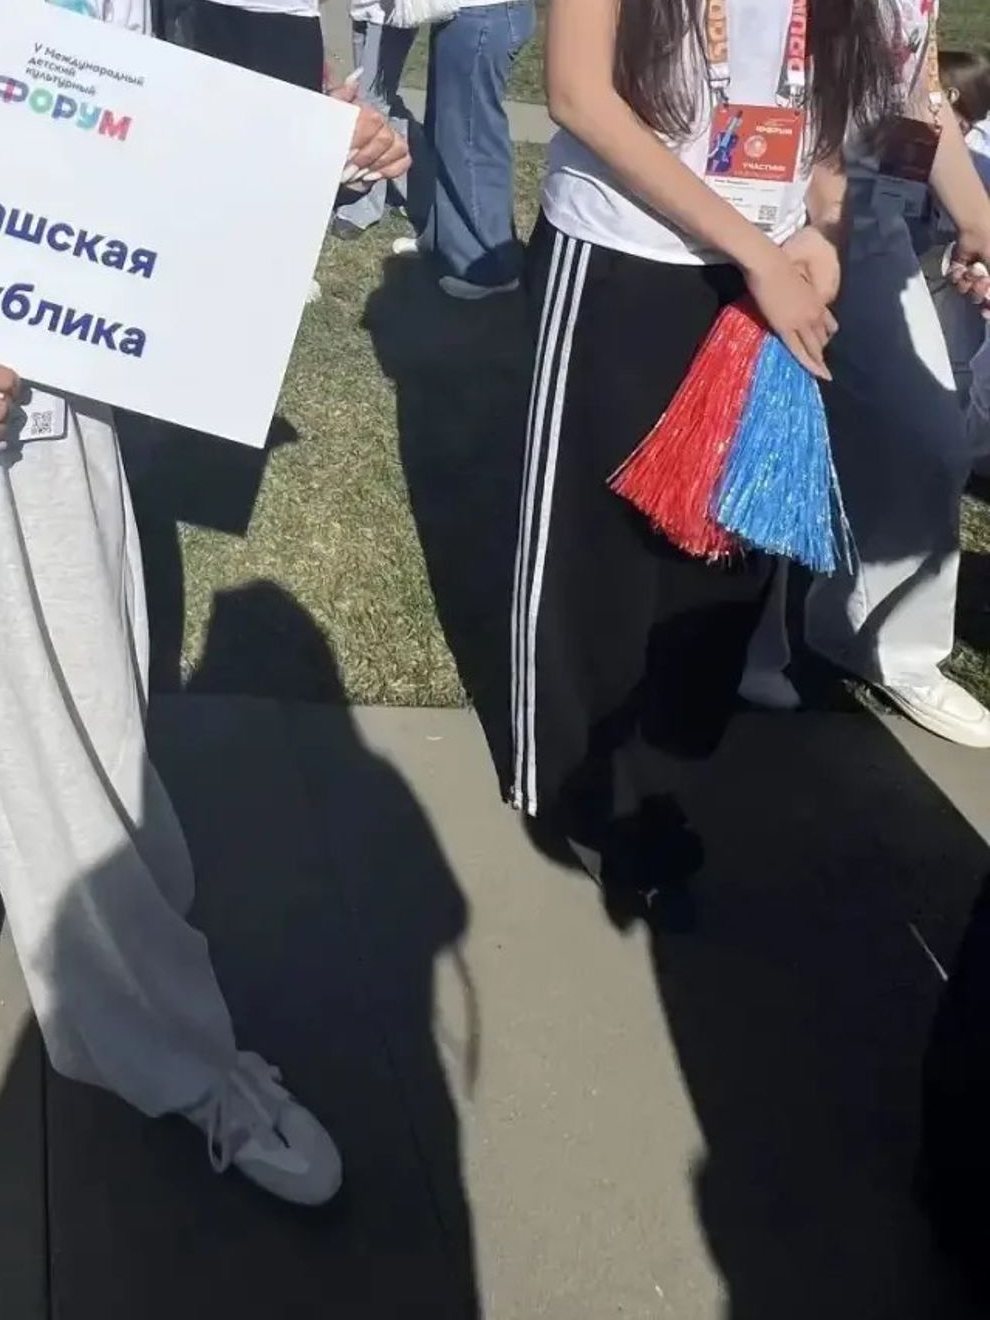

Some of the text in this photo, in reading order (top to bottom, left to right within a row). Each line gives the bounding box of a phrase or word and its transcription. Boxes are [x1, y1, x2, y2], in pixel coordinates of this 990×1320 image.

[27, 56, 76, 77] детский
[34, 42, 146, 87] V Международный
[25, 66, 97, 96] культурный
